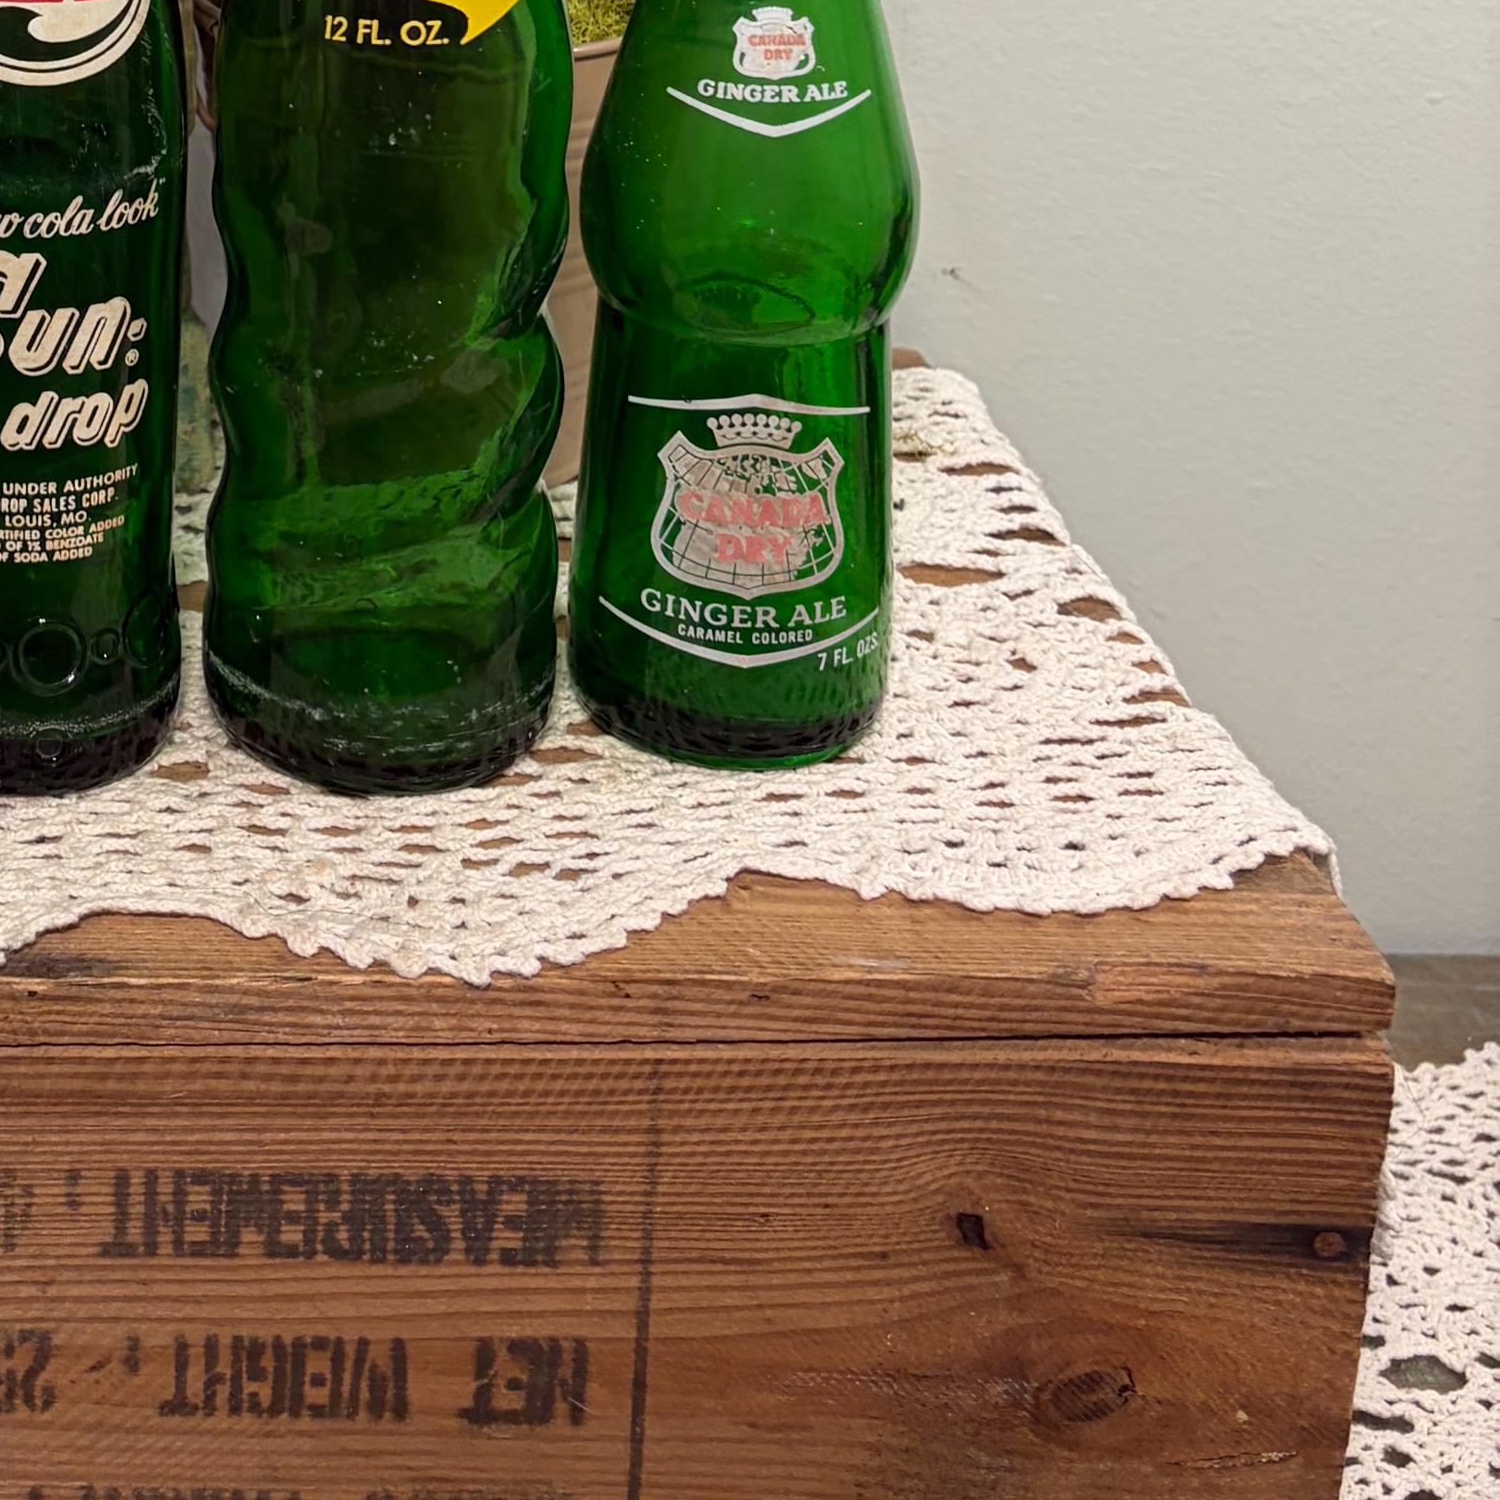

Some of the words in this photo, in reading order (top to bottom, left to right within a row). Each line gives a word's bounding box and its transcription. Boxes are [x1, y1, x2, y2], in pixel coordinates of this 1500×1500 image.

[324, 14, 348, 42] 12
[356, 18, 392, 45] FL.
[399, 19, 450, 45] OZ.
[763, 48, 794, 62] DRY
[696, 78, 801, 103] GINGER
[803, 80, 849, 102] ALE
[23, 195, 95, 239] cola
[0, 378, 148, 451] drop
[2, 481, 57, 496] UNDER
[63, 462, 139, 494] AUTHORITY
[32, 494, 76, 513] SALES
[81, 486, 119, 508] CORP.
[676, 490, 830, 529] CANADA
[5, 540, 24, 552] OF
[45, 532, 104, 551] BENZOATE
[45, 525, 85, 540] COLOR
[88, 515, 125, 534] ADDED
[14, 551, 49, 563] SODA
[52, 546, 93, 562] ADDED
[715, 532, 794, 565] DRY
[640, 587, 781, 629] GINGER
[787, 595, 848, 627] ALE
[677, 623, 743, 645] CARAMEL
[751, 629, 814, 645] COLORED
[817, 652, 827, 672] 7
[457, 1334, 590, 1427] NET
